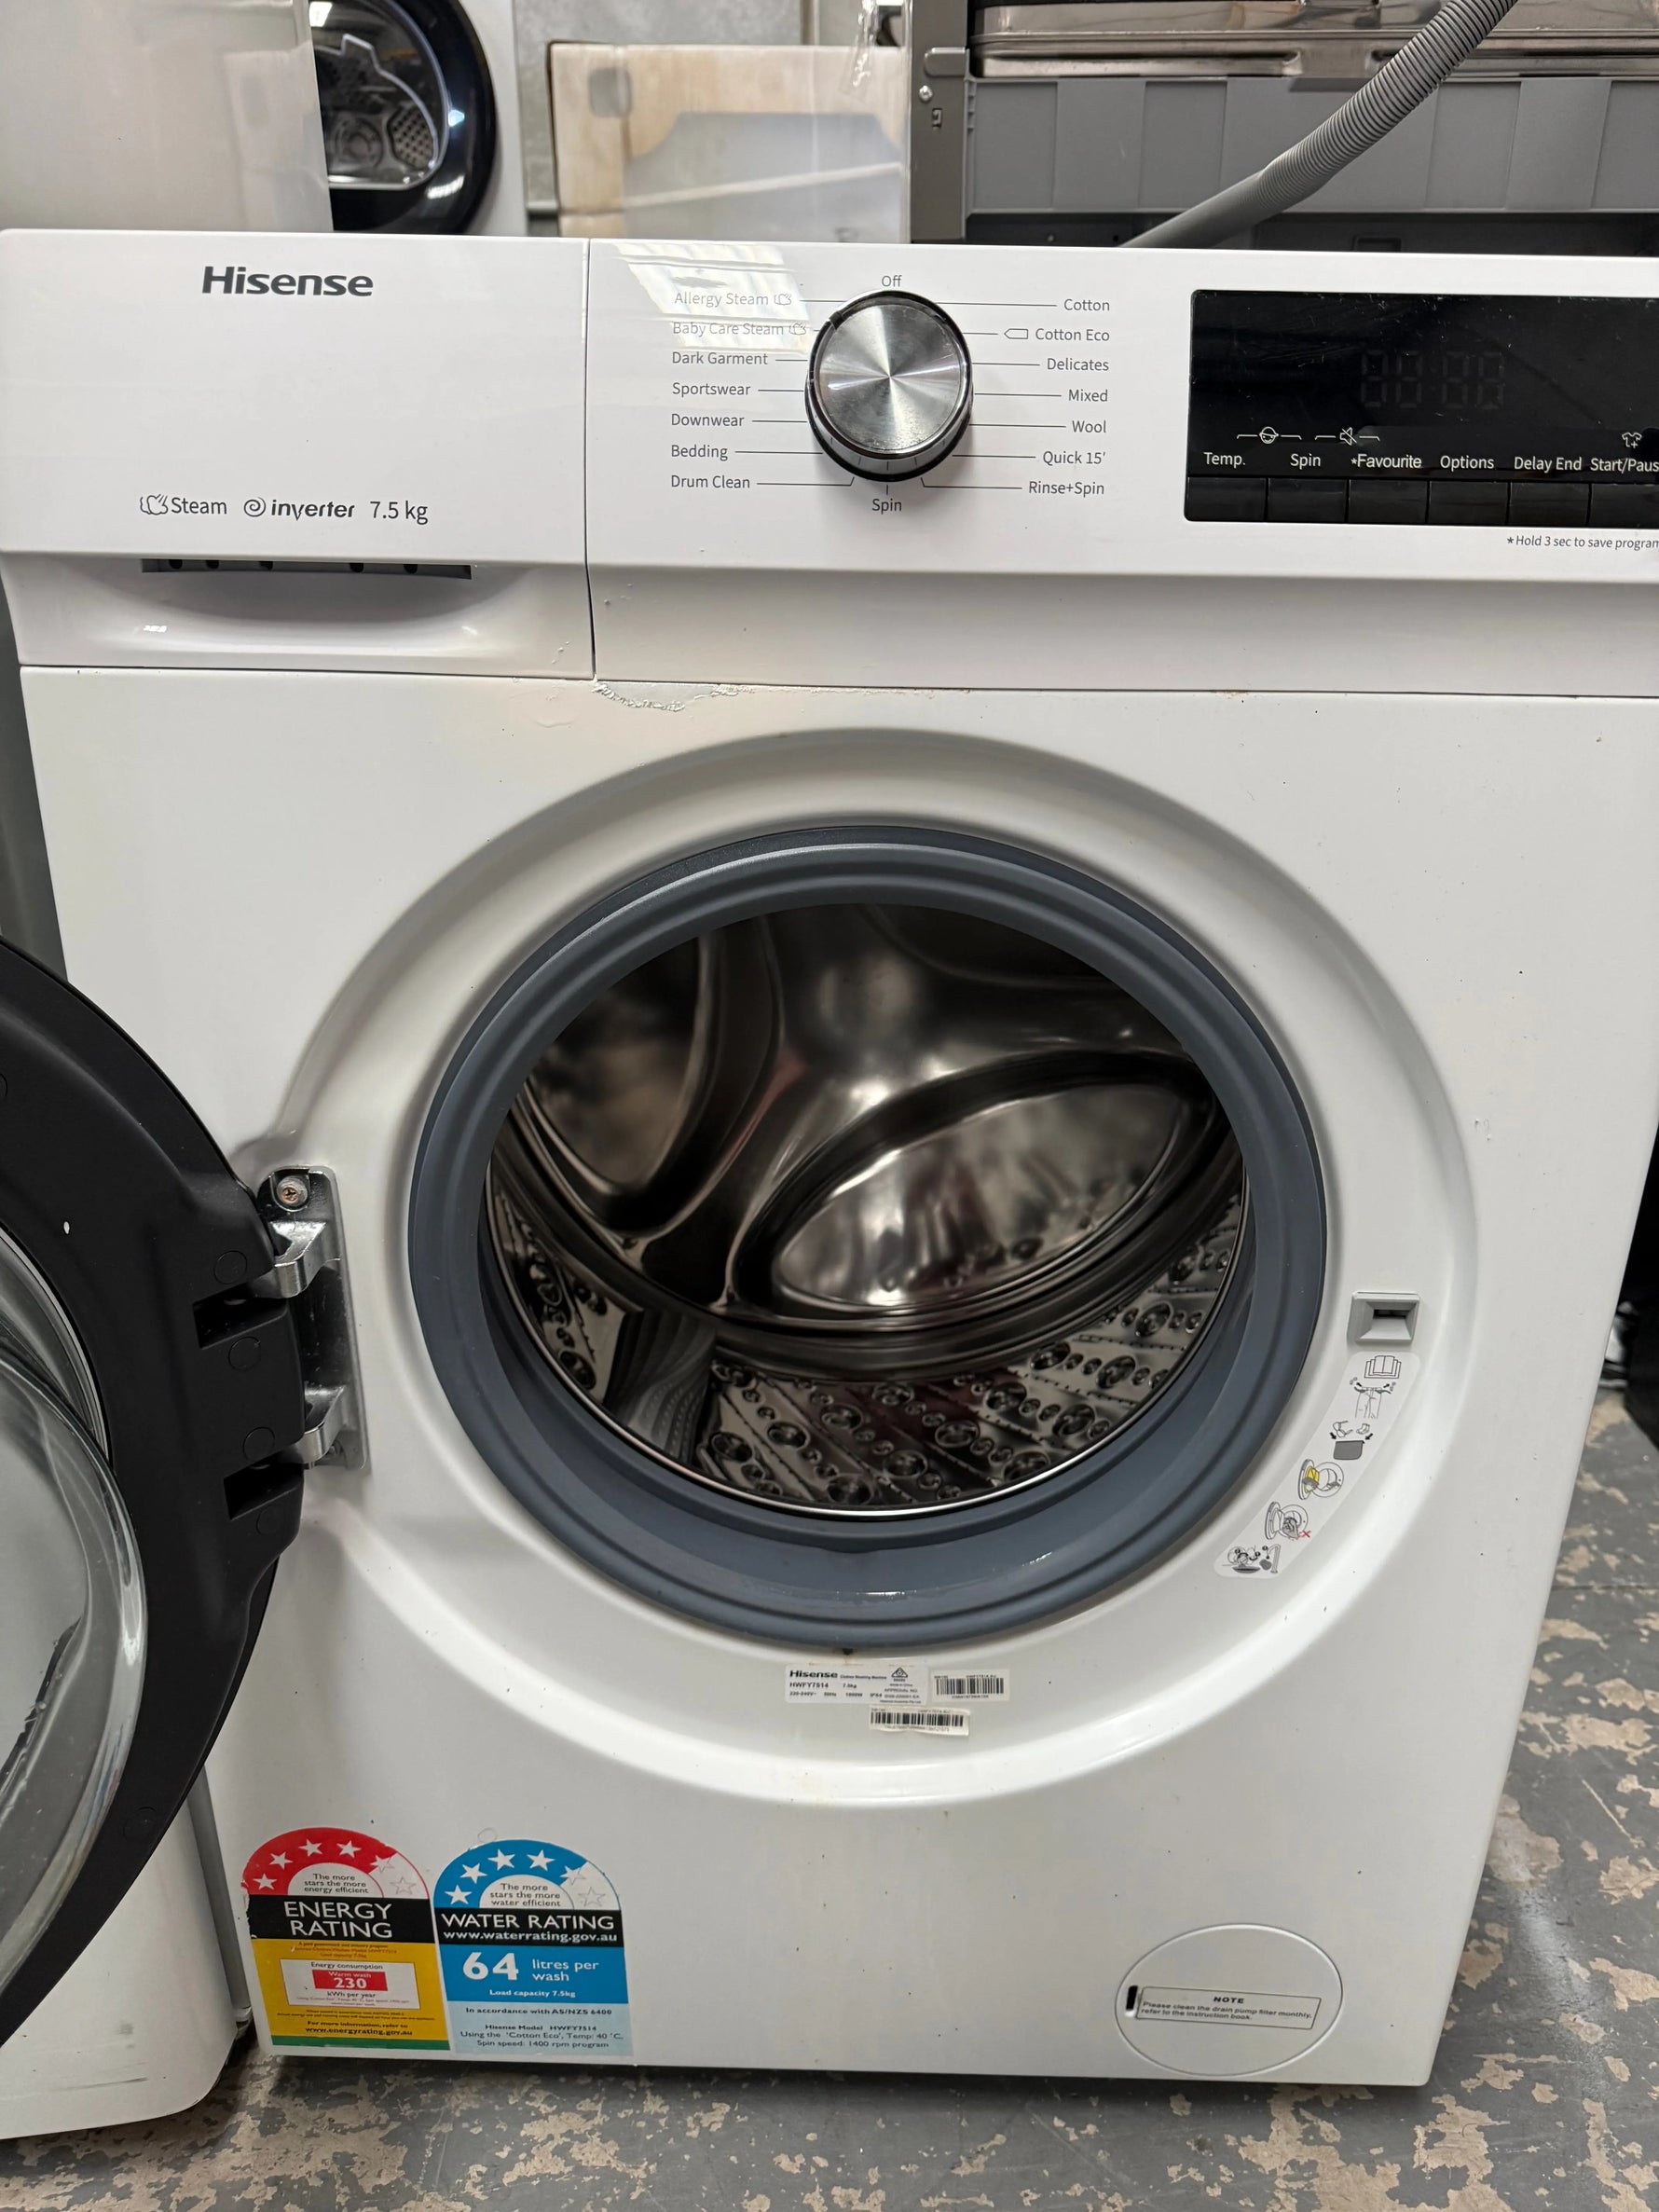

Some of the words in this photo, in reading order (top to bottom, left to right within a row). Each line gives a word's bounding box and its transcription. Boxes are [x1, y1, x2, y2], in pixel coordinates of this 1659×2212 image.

[201, 266, 374, 296] Hisense
[881, 274, 903, 289] Off
[674, 292, 722, 308] Allergy
[725, 293, 769, 306] Steam
[1063, 298, 1110, 312] Cotton
[673, 322, 706, 337] Baby
[709, 323, 739, 335] Care
[742, 323, 785, 336] Steam
[1035, 328, 1081, 341] Cotton
[1086, 329, 1110, 341] Eco
[672, 351, 704, 364] Dark
[707, 351, 769, 365] Garment
[1047, 357, 1109, 371] Delicates
[672, 382, 751, 398] Sportswear
[1068, 389, 1109, 403] Mixed
[671, 413, 745, 427] Downwear
[1072, 420, 1107, 433] Wool
[671, 445, 728, 461] Bedding
[1042, 450, 1082, 467] Quick
[1203, 452, 1246, 469] Temp.
[1290, 453, 1321, 470] Spin
[1440, 455, 1495, 472] Options
[1514, 456, 1552, 474] Delay
[1556, 456, 1582, 471] End
[671, 474, 708, 488] Drum
[712, 474, 750, 489] Clean
[1028, 481, 1105, 498] Rinse+Spin
[171, 497, 227, 515] Steam
[271, 500, 355, 521] inverter
[370, 501, 399, 519] 7.5
[404, 501, 429, 526] kg
[871, 498, 903, 514] Spin
[1544, 536, 1551, 546] 3
[1554, 538, 1571, 547] sec
[1574, 537, 1585, 548] to
[1588, 540, 1612, 548] save
[789, 1669, 838, 1679] Hisense
[500, 1882, 519, 1890] The
[283, 1901, 392, 1920] ENERGY
[522, 1899, 561, 1907] efficient
[290, 1920, 392, 1939] RATING
[441, 1914, 520, 1929] WATER
[528, 1916, 614, 1930] RATING
[443, 1930, 618, 1944] www.waterrating.gov.au
[462, 1951, 519, 1981] 64
[531, 1958, 569, 1971] litres
[574, 1961, 599, 1972] per
[334, 1977, 367, 1989] 230
[531, 1971, 569, 1982] wash
[552, 1990, 576, 1999] 7.5kg
[1213, 1996, 1244, 2004] NOTE
